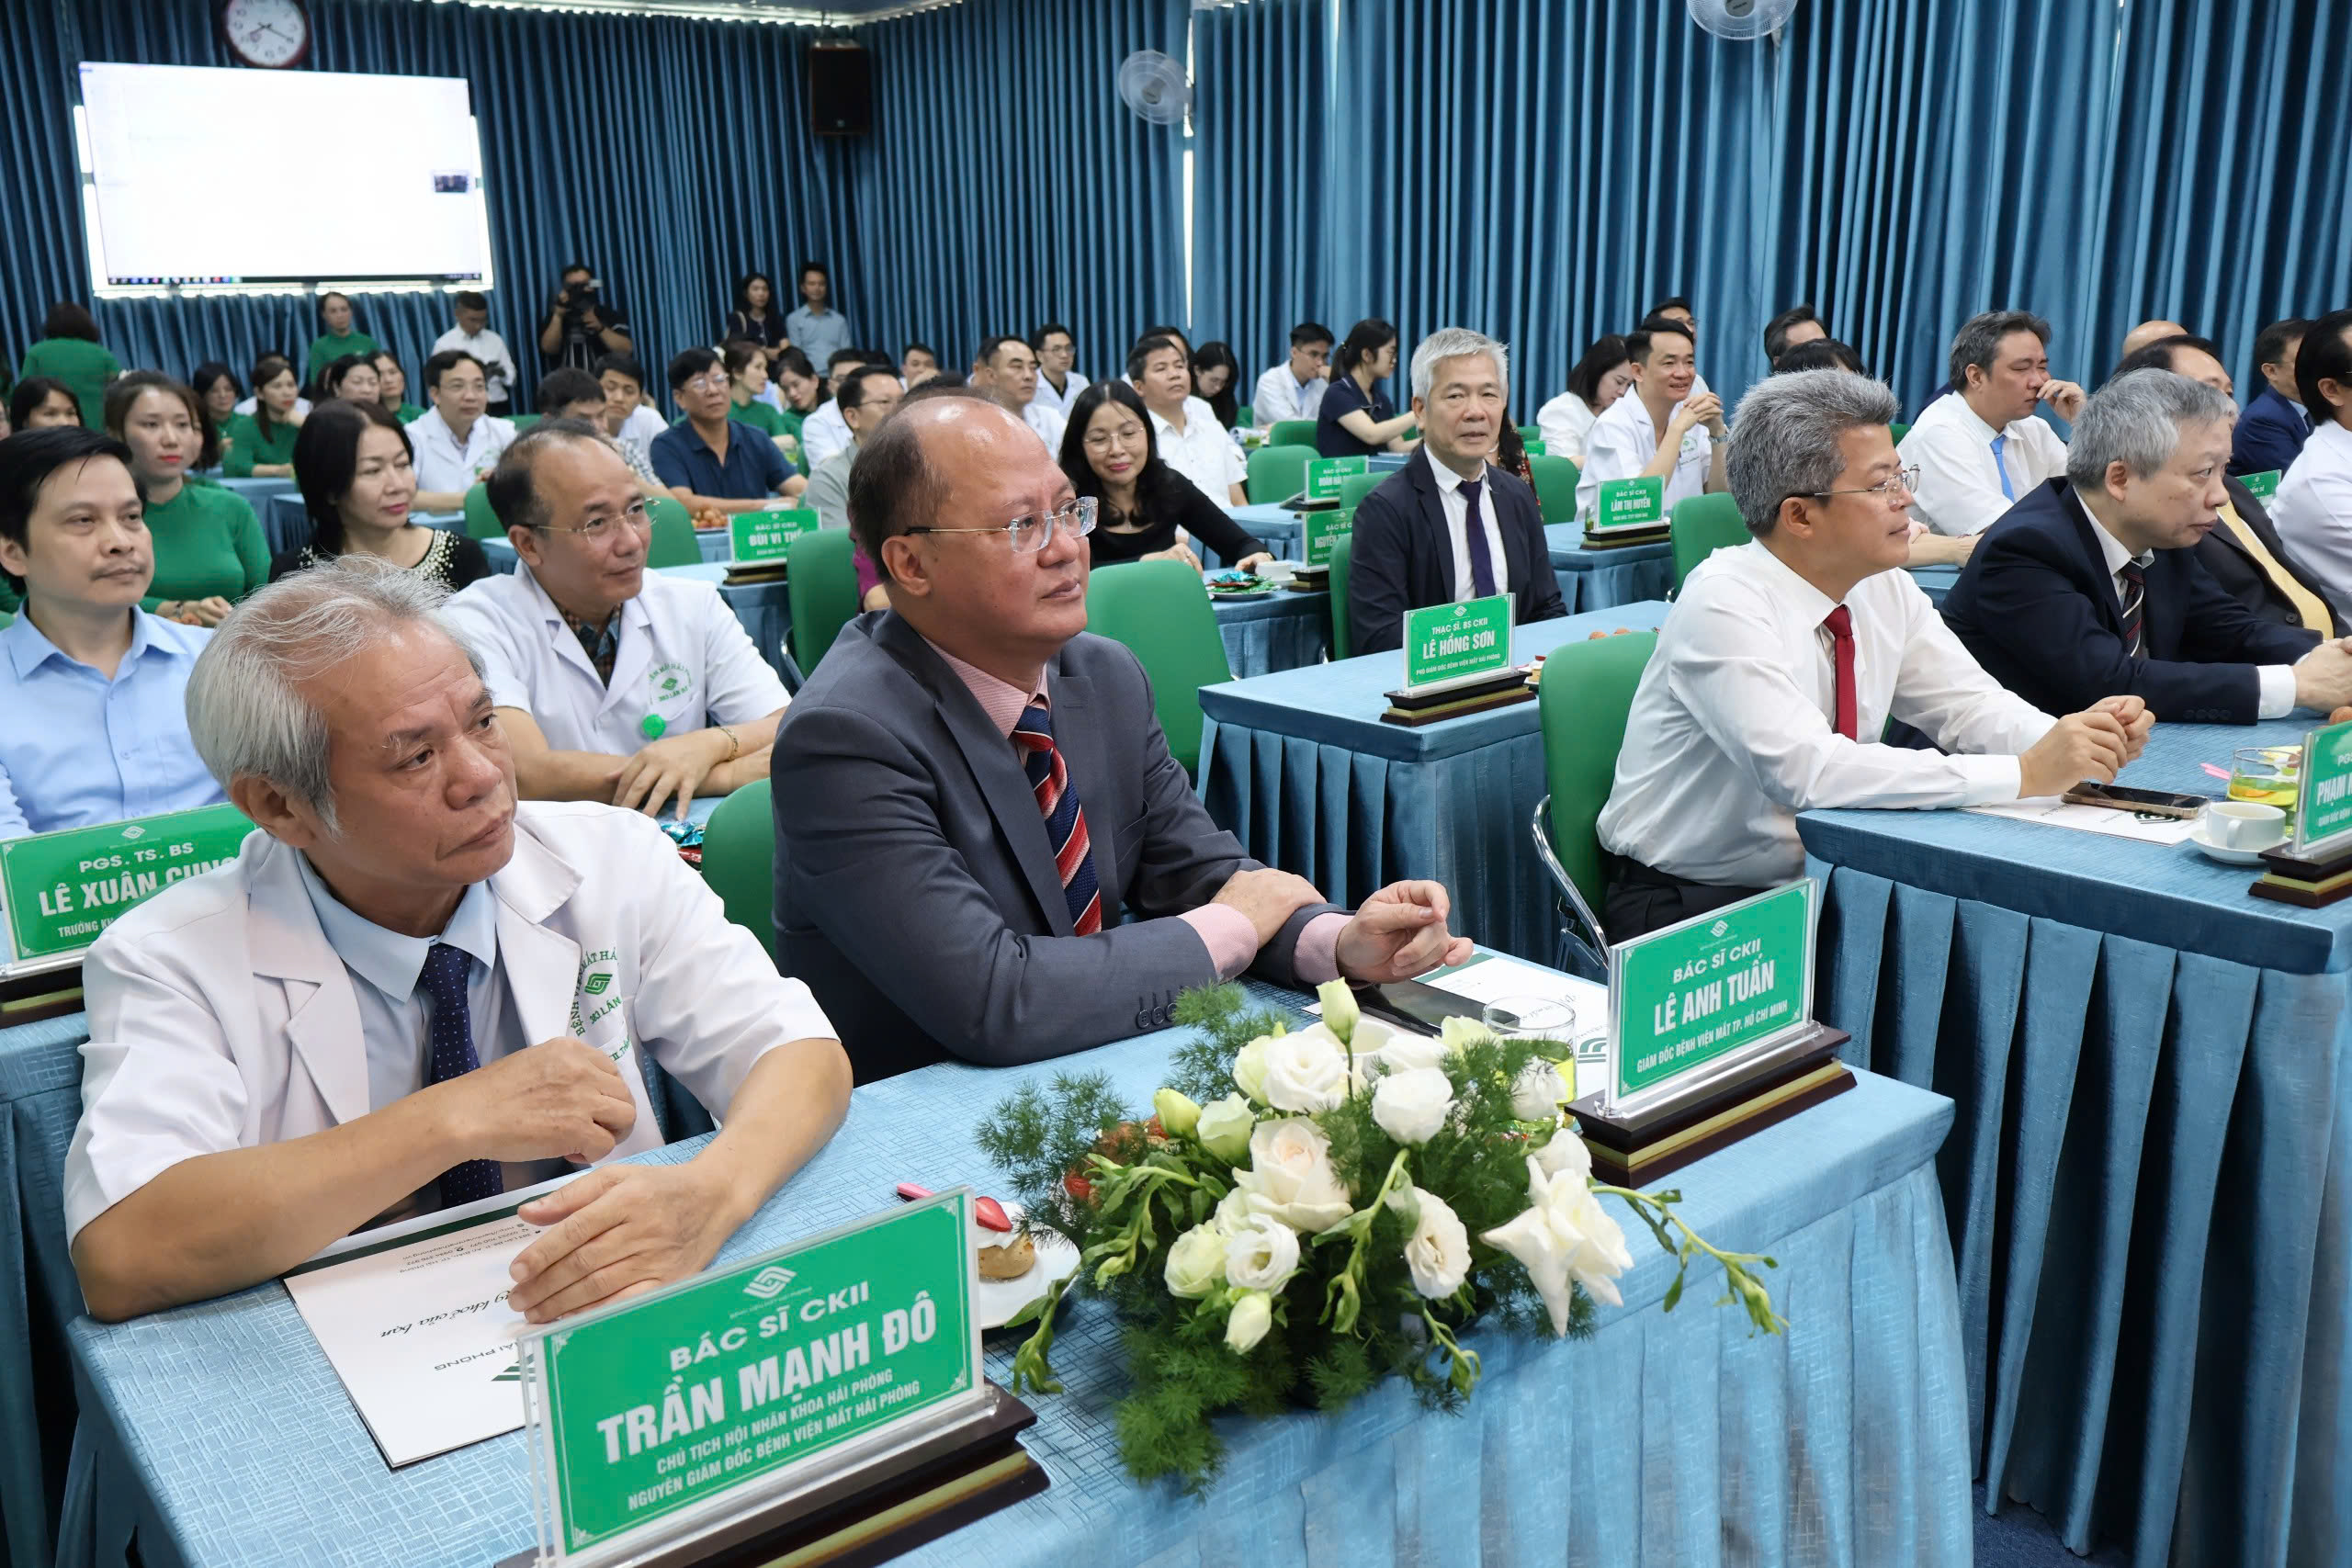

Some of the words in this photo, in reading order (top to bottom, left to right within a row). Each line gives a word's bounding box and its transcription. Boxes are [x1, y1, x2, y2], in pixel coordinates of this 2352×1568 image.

[1422, 637, 1436, 660] LÊ
[1439, 634, 1470, 657] HỒNG
[1472, 628, 1495, 650] SƠN
[1431, 623, 1452, 635] THẠC
[1463, 620, 1472, 629] BS
[2337, 753, 2352, 767] PG
[2316, 775, 2346, 807] PHẠM
[168, 841, 194, 856] BS
[39, 883, 74, 917] LÊ
[80, 870, 157, 909] XUÂN
[1672, 958, 1707, 984] BÁC
[1712, 947, 1725, 969] SĨ
[1729, 938, 1761, 961] CKII
[1654, 992, 1677, 1036] LÊ
[1681, 980, 1722, 1025] ANH
[1726, 953, 1775, 1006] TUẤN
[1636, 1053, 1657, 1073] GIÁM
[1657, 1044, 1675, 1065] ĐỐC
[1675, 1036, 1696, 1057] BỆNH
[1697, 1029, 1713, 1048] VIỆN
[1714, 1021, 1731, 1041] MẮT
[1732, 1019, 1743, 1033] TP.
[1755, 1007, 1769, 1023] CHÍ
[1770, 998, 1788, 1018] MINH
[380, 1323, 413, 1337] bạn
[418, 1312, 448, 1325] của
[670, 1326, 748, 1372] BÁC
[758, 1304, 790, 1337] SĨ
[799, 1280, 869, 1322] CKII
[434, 1348, 496, 1371] PHÒNG
[596, 1374, 726, 1465] TRẦN
[739, 1322, 869, 1411] MẠNH
[882, 1290, 936, 1356] ĐÔ
[656, 1446, 686, 1474] CHỦ
[689, 1435, 722, 1461] TỊCH
[724, 1424, 749, 1449] HỘI
[751, 1409, 787, 1437] NHÃN
[789, 1394, 825, 1421] KHOA
[827, 1383, 849, 1406] HẢI
[850, 1367, 893, 1397] PHÒNG
[628, 1475, 684, 1511] NGUYÊN
[685, 1459, 722, 1487] GIÁM
[724, 1445, 752, 1472] ĐỐC
[755, 1431, 791, 1459] BỆNH
[793, 1417, 823, 1443] VIỆN
[825, 1404, 854, 1430] MẮT
[854, 1394, 877, 1418] HẢI
[878, 1379, 921, 1409] PHÒNG
